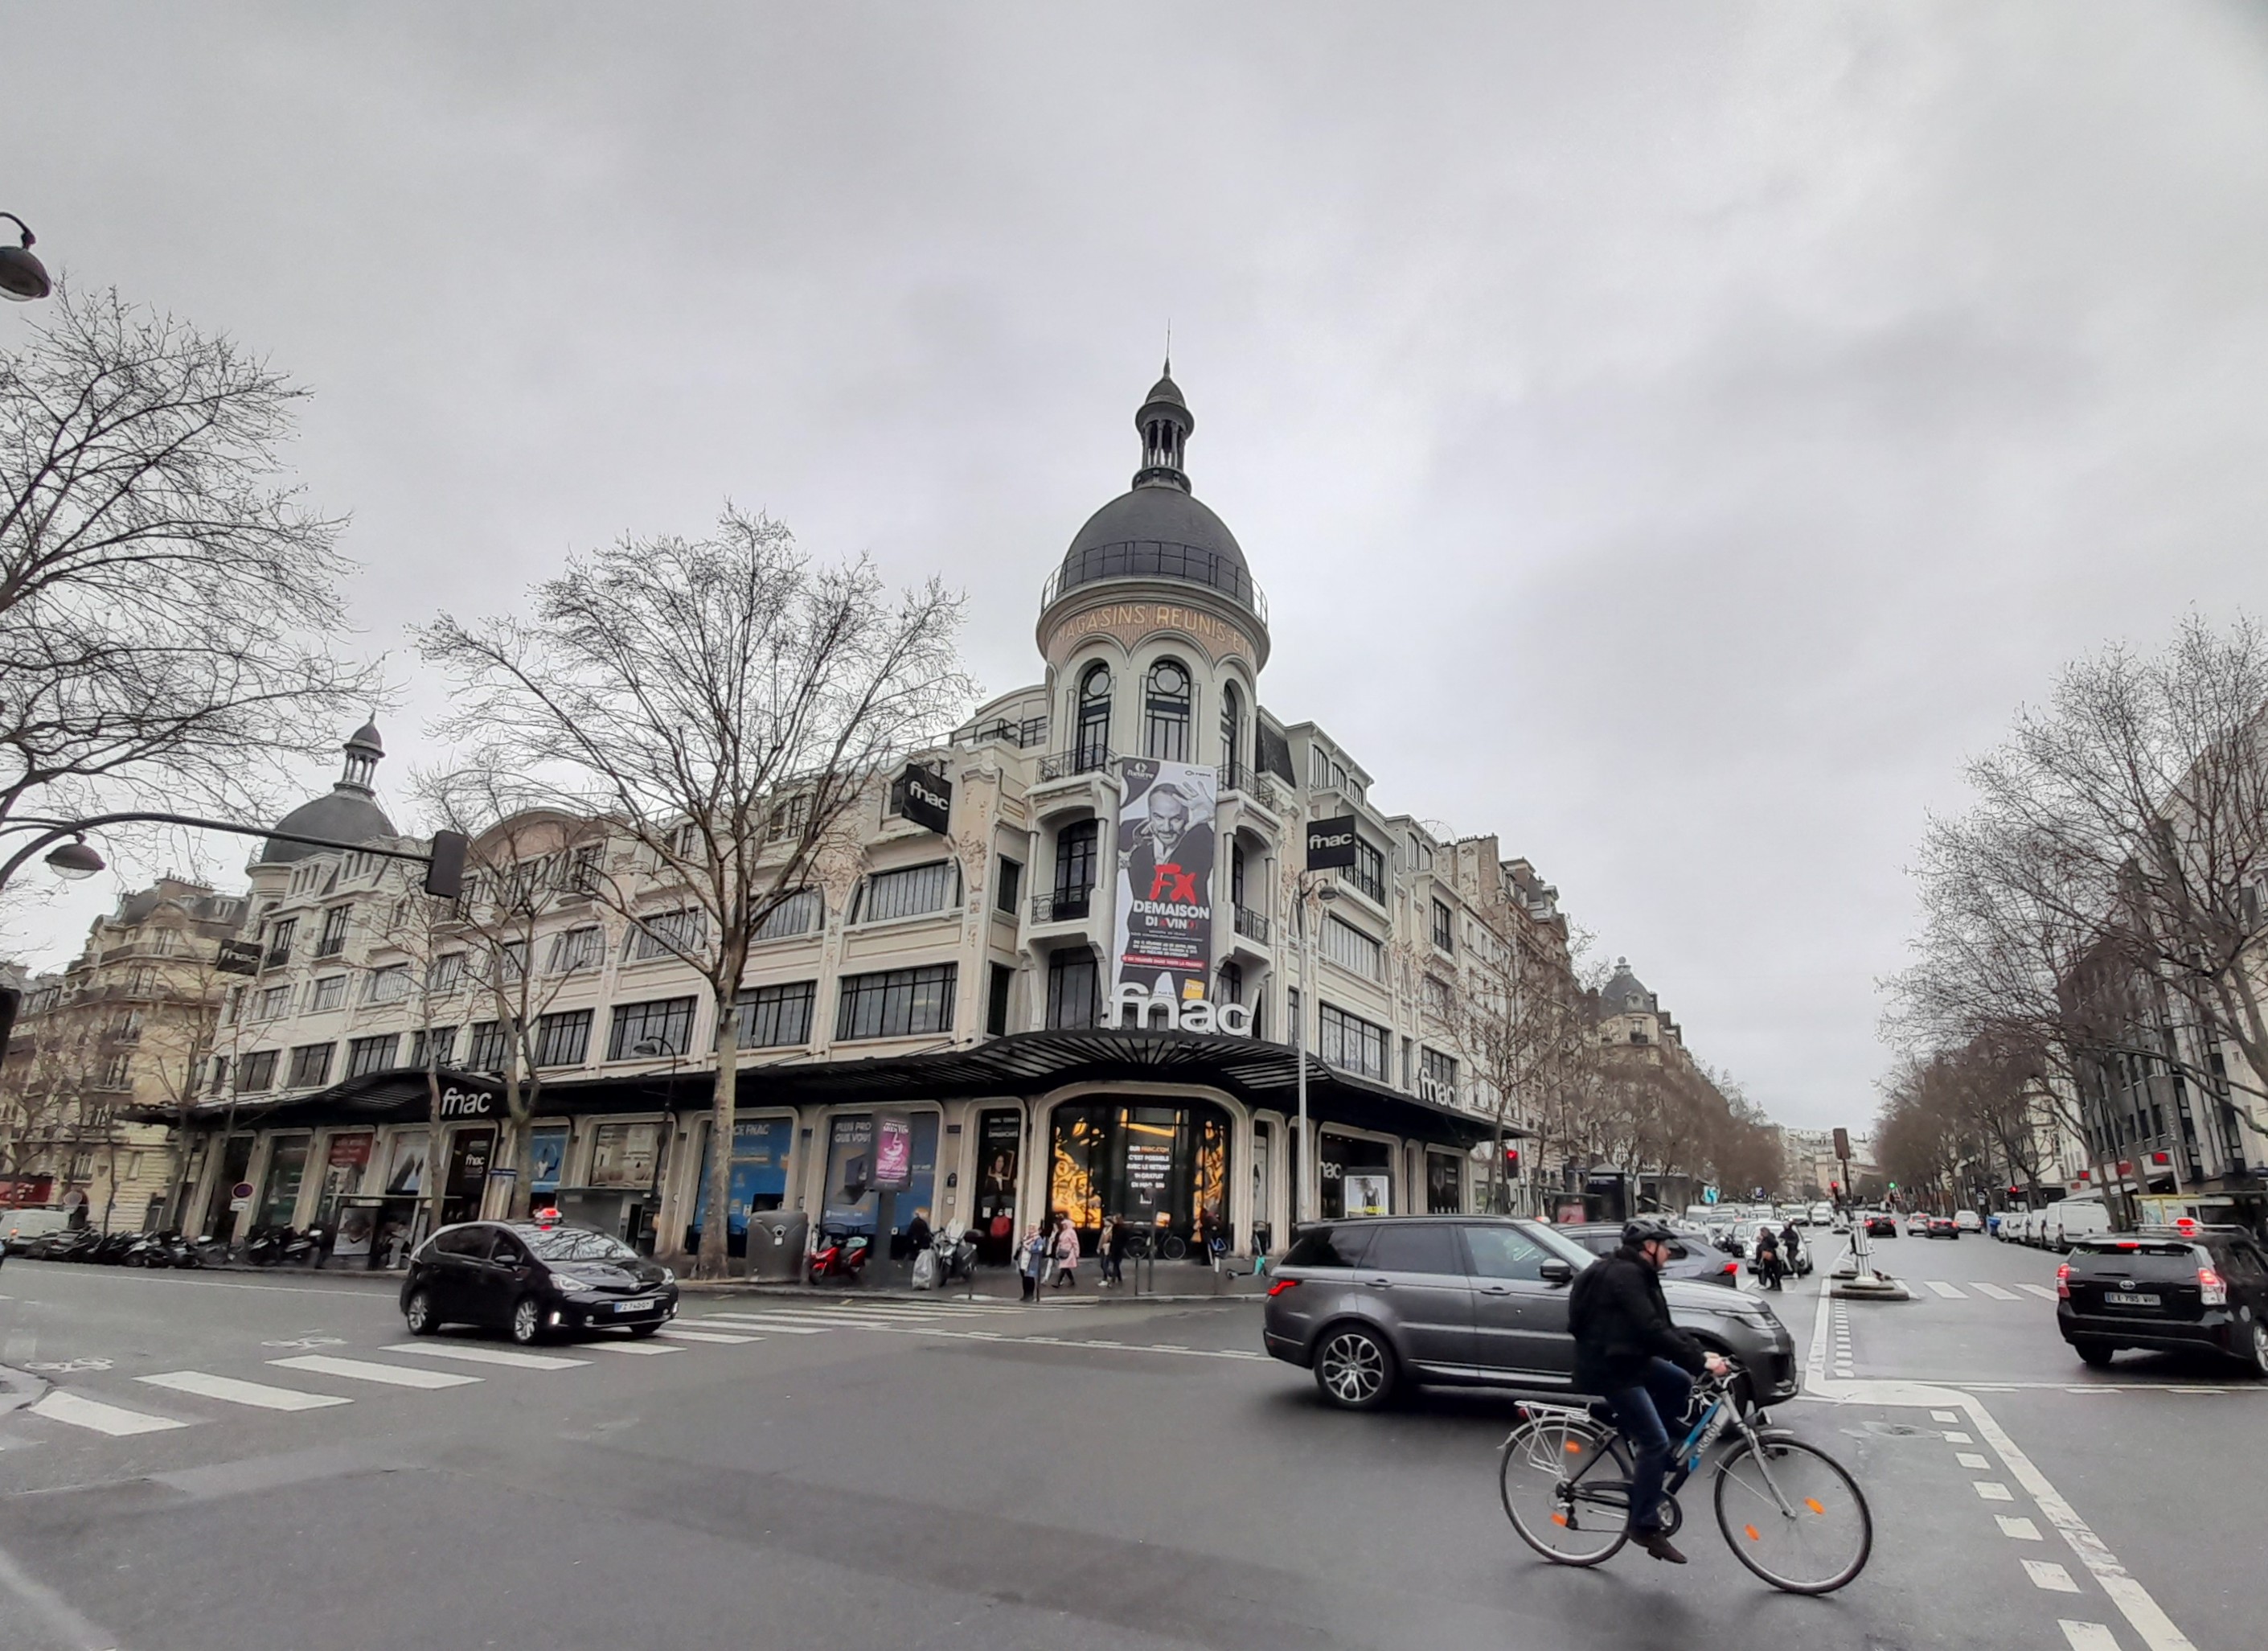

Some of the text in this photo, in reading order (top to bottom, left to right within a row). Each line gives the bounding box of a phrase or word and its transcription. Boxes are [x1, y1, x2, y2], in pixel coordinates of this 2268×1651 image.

[909, 781, 949, 811] fnac
[1309, 833, 1354, 851] fnac
[1133, 900, 1211, 921] DEMAISON
[221, 948, 260, 963] fnac
[1109, 982, 1252, 1037] fnac
[1420, 1066, 1456, 1109] fnac
[441, 1086, 492, 1115] fnac
[745, 1124, 769, 1136] FNAC
[855, 1122, 872, 1131] PRO
[465, 1154, 486, 1165] fnac
[1319, 1161, 1342, 1180] nac
